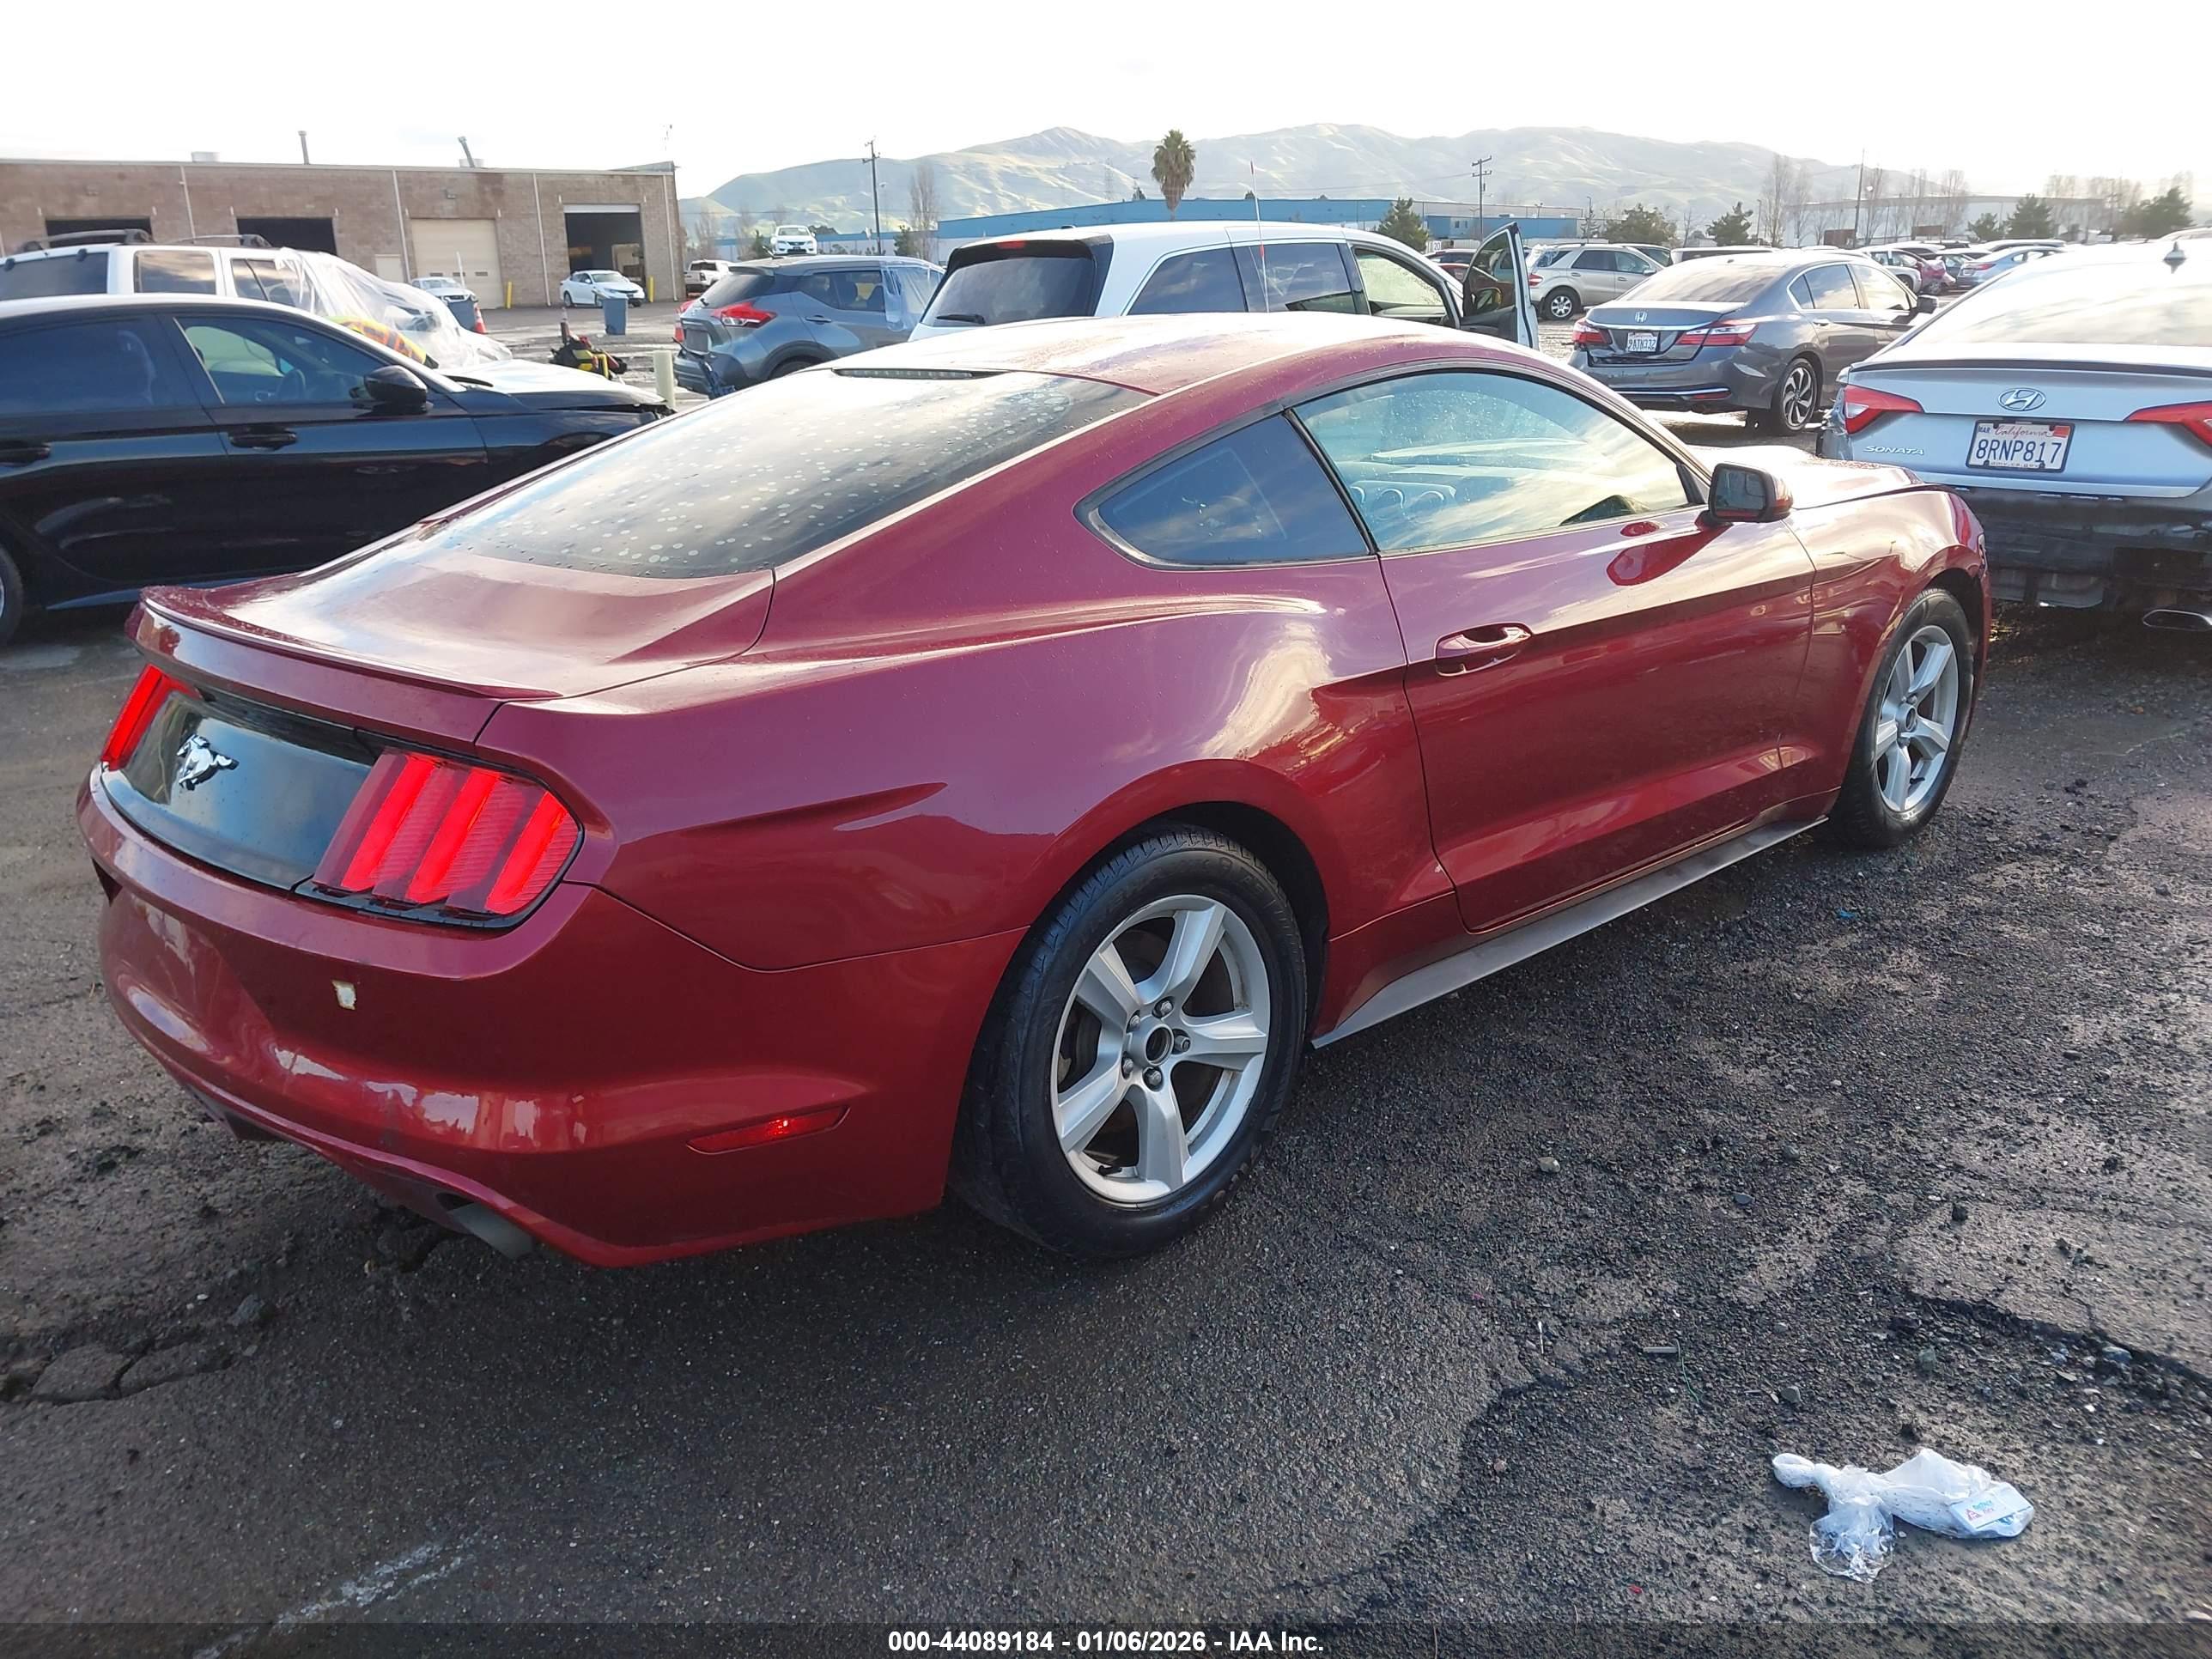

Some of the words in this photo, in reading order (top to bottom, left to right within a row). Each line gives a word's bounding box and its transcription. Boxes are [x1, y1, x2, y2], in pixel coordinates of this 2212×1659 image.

[1995, 425, 2053, 439] California
[1863, 446, 1924, 455] SONATA
[1976, 439, 2062, 464] 8RNP817
